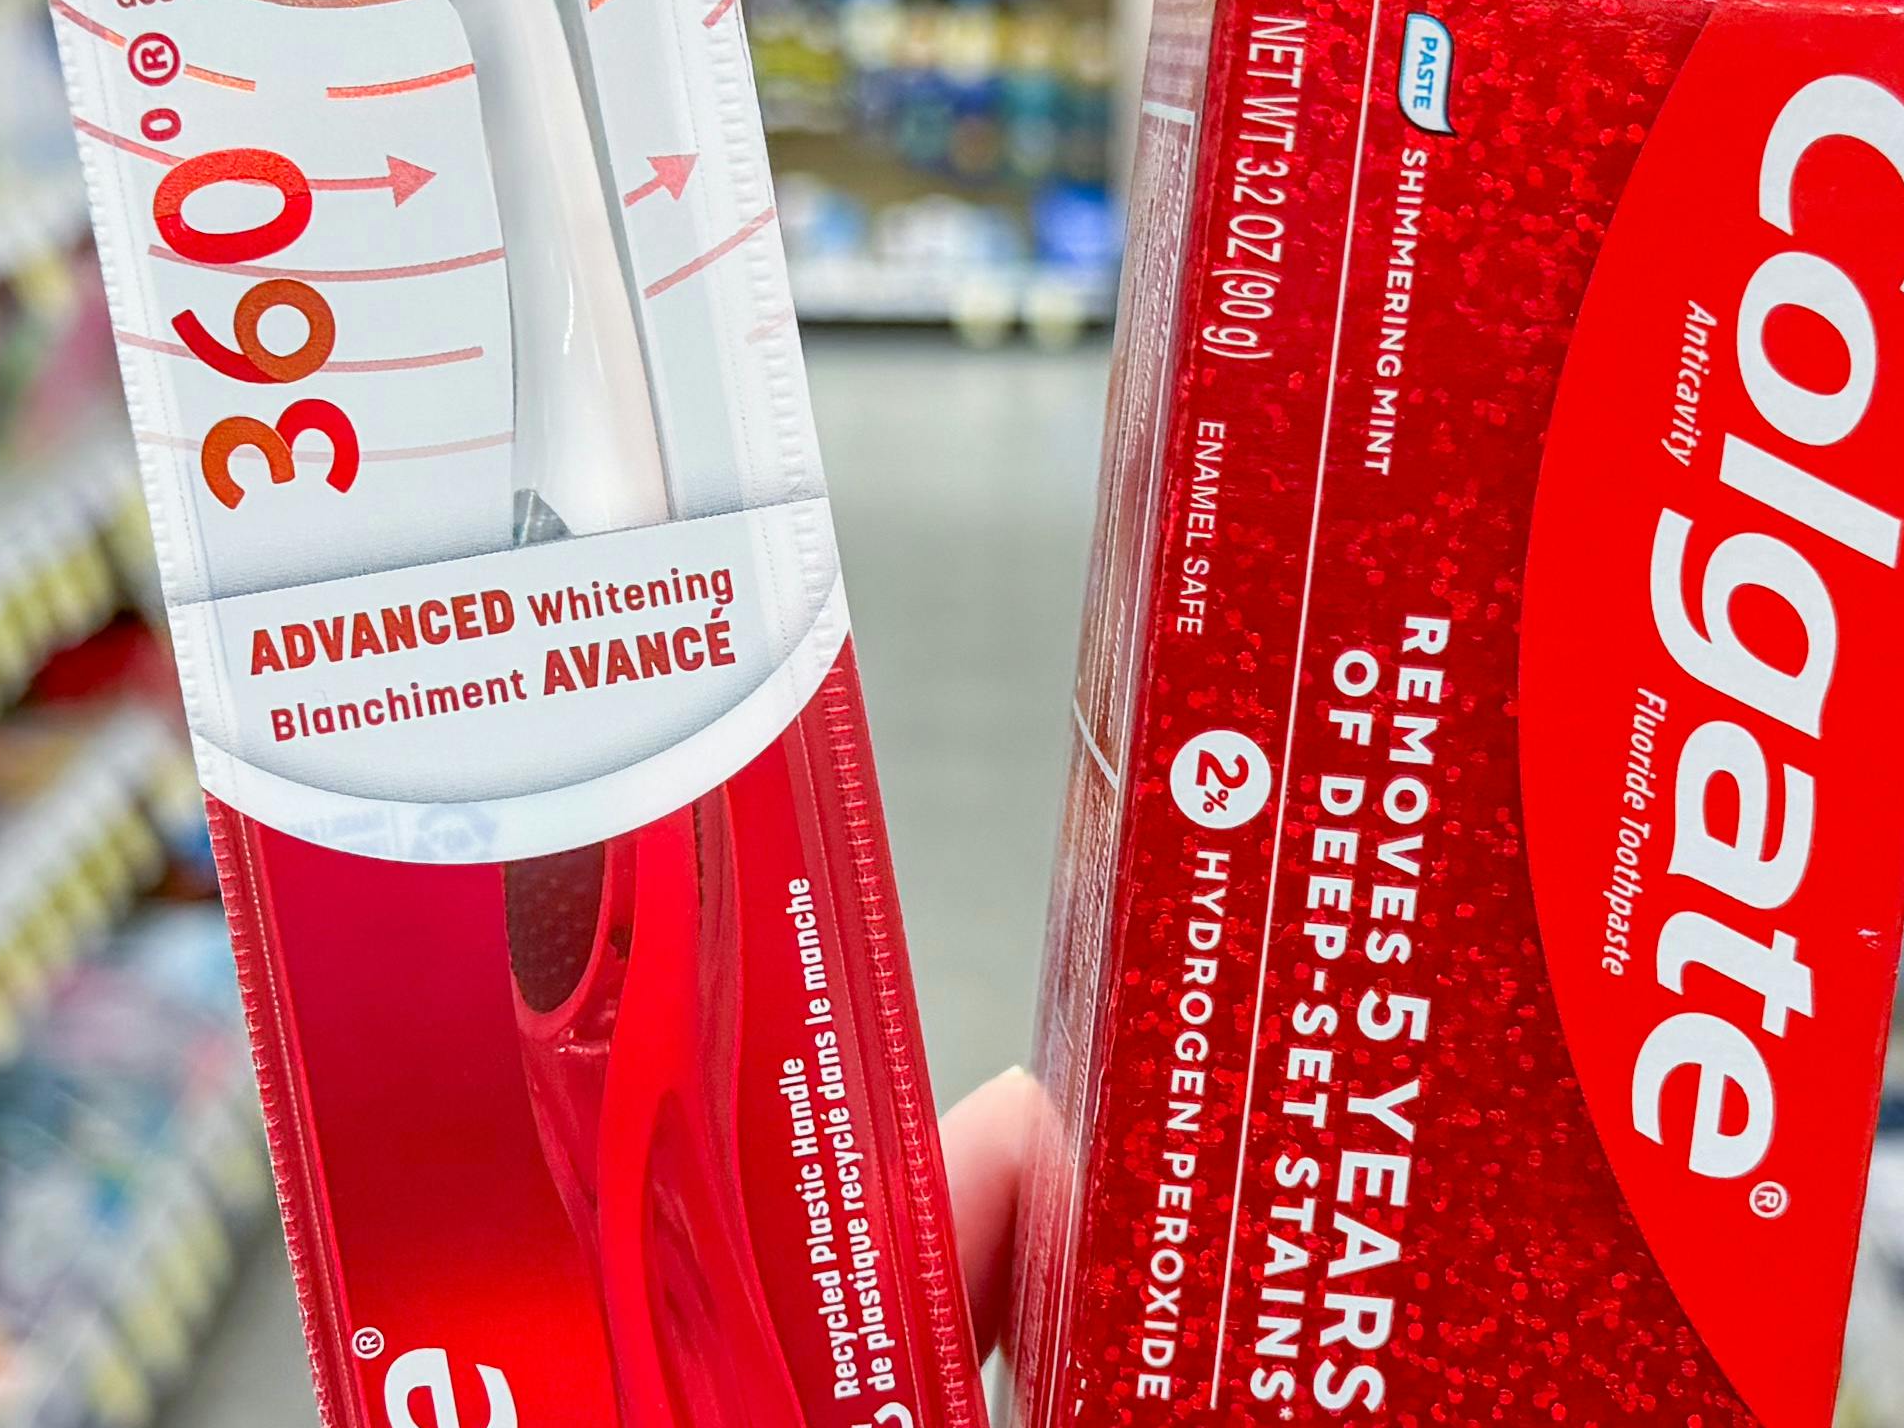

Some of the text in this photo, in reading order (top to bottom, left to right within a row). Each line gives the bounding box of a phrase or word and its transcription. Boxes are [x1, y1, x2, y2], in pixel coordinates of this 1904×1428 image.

[1410, 34, 1438, 111] PASTE
[1201, 14, 1306, 360] NET WT 3.2 OZ (90 g)
[1363, 147, 1428, 476] SHIMMERING MINT
[1660, 299, 1718, 469] Anticavity
[250, 567, 735, 676] ADVANCED Whitening
[1176, 418, 1226, 635] ENAMEL SAFE
[270, 607, 736, 743] Blanchiment AVANCÉ
[1327, 650, 1380, 747] OF
[1601, 687, 1668, 977] Fluoride Toothpaste
[1282, 774, 1366, 1129] DEEP-SET
[1312, 615, 1452, 1414] REMOVES 5 YEARS
[779, 1058, 820, 1158] Handle
[785, 877, 896, 1393] de plastique recyclé dans le manche
[1136, 749, 1250, 1401] 2% HYDROGEN PEROXIDE
[812, 1269, 861, 1400] Recycled
